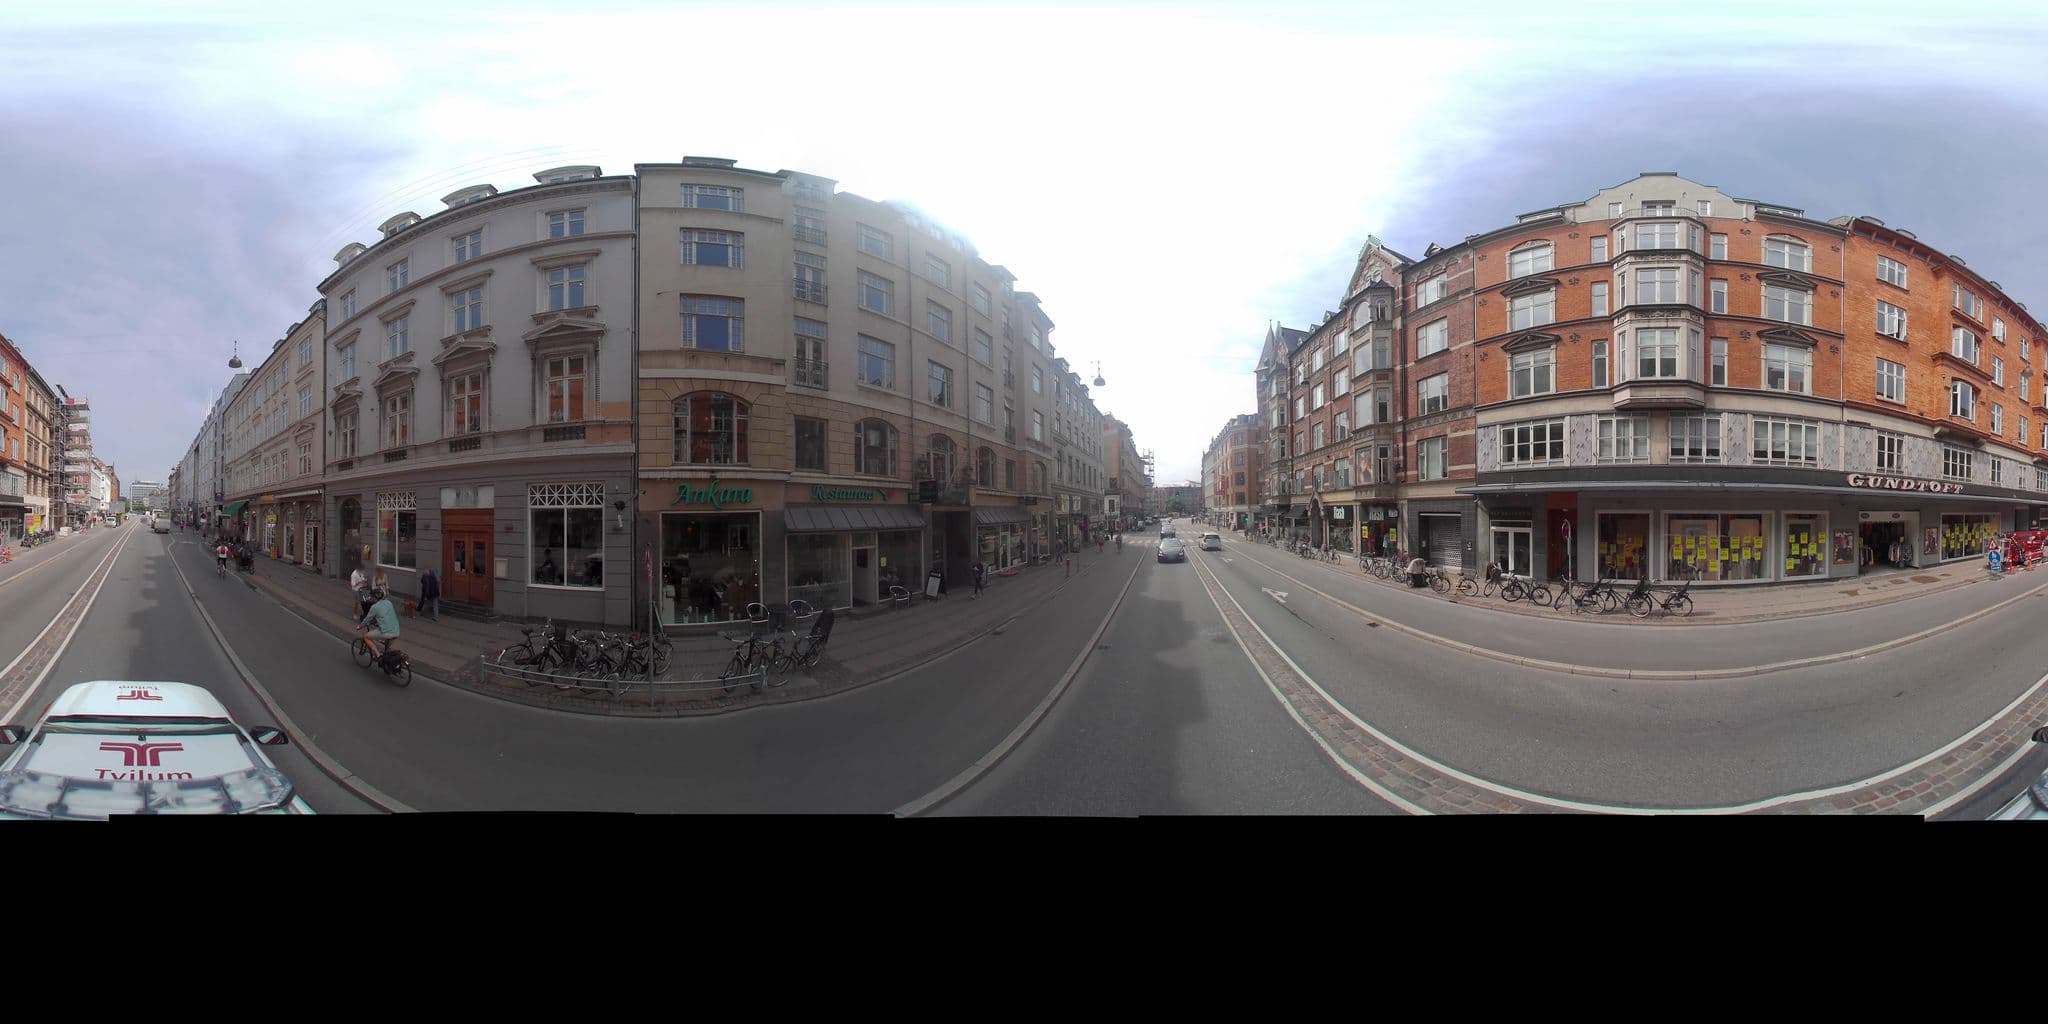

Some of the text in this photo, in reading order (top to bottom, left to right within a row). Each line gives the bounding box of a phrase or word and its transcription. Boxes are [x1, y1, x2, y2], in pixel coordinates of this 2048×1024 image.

[811, 484, 876, 502] Restaurant
[1847, 473, 1964, 494] GUNDTOFT
[673, 479, 753, 509] Ankara
[95, 768, 193, 782] Tvilum
